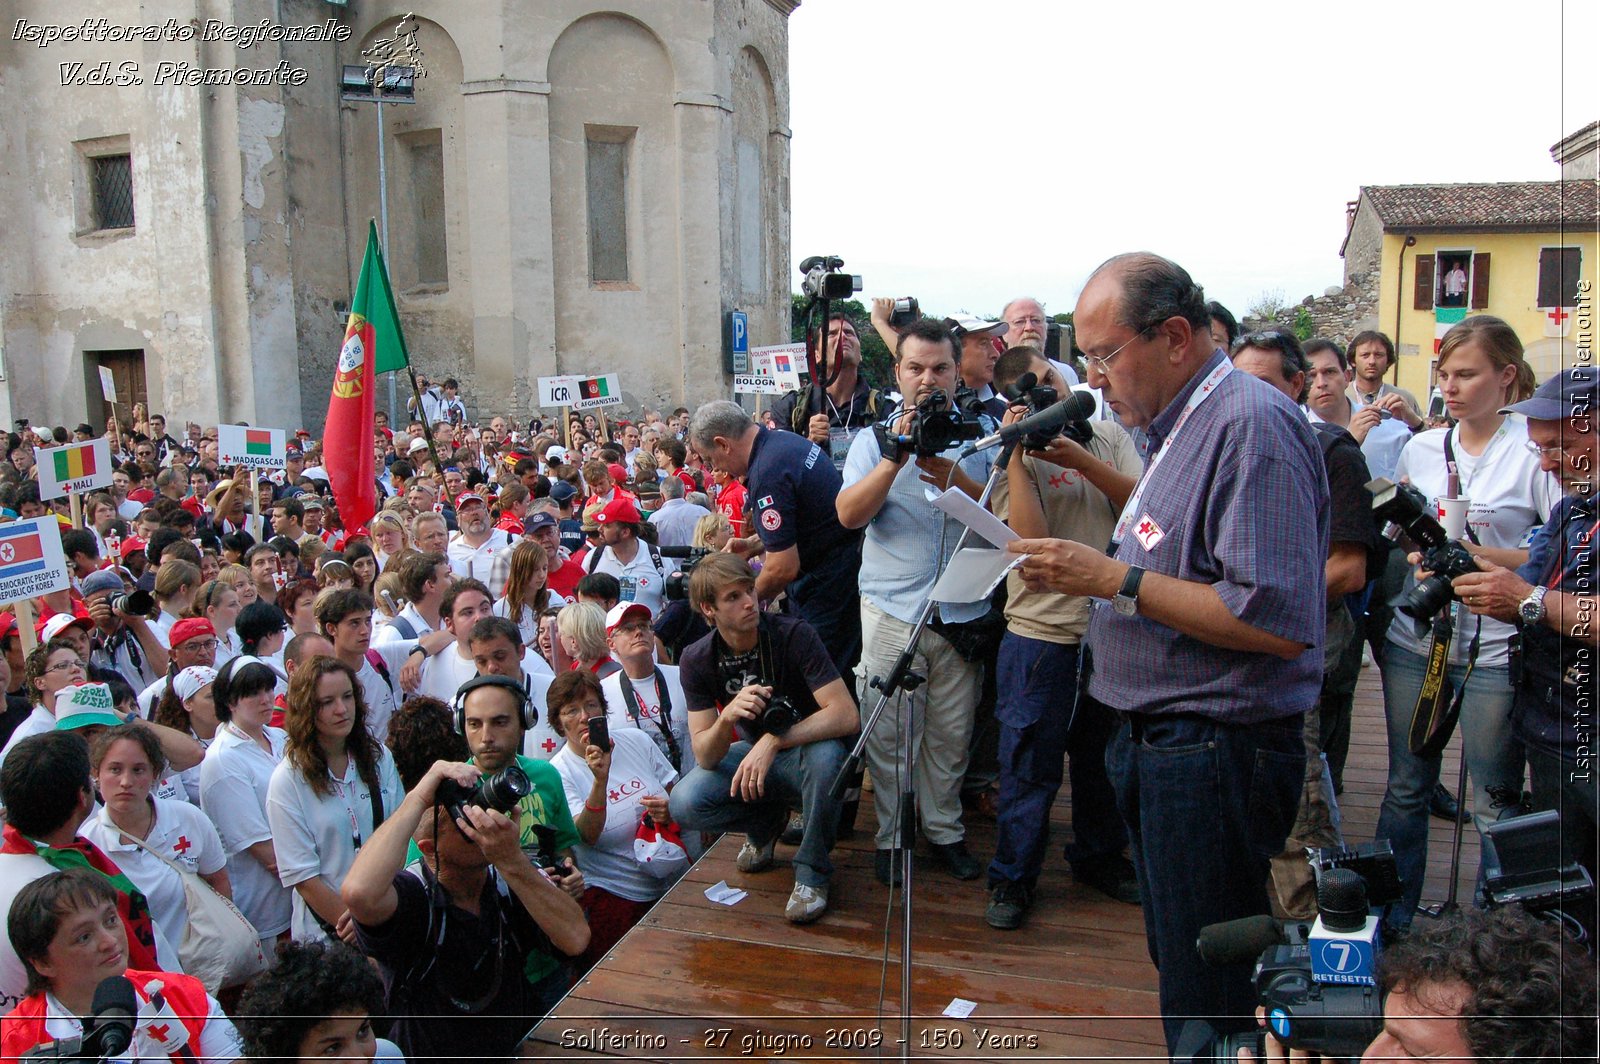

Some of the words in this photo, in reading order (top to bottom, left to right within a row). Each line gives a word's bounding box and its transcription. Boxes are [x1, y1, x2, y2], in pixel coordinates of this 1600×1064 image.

[735, 318, 745, 348] P
[736, 378, 775, 386] BOLOGN
[581, 397, 619, 408] AFGHANISTAN
[233, 456, 284, 466] MADAGASCAR
[73, 478, 93, 490] MALI
[0, 575, 34, 591] EMOCRATIC
[35, 570, 60, 583] PEOPLE'S
[26, 584, 35, 594] OF
[35, 580, 55, 591] KOREA
[1431, 642, 1444, 674] Nikon
[1330, 943, 1350, 971] 7
[1314, 973, 1375, 985] RETESETTE
[1274, 1011, 1285, 1035] 7
